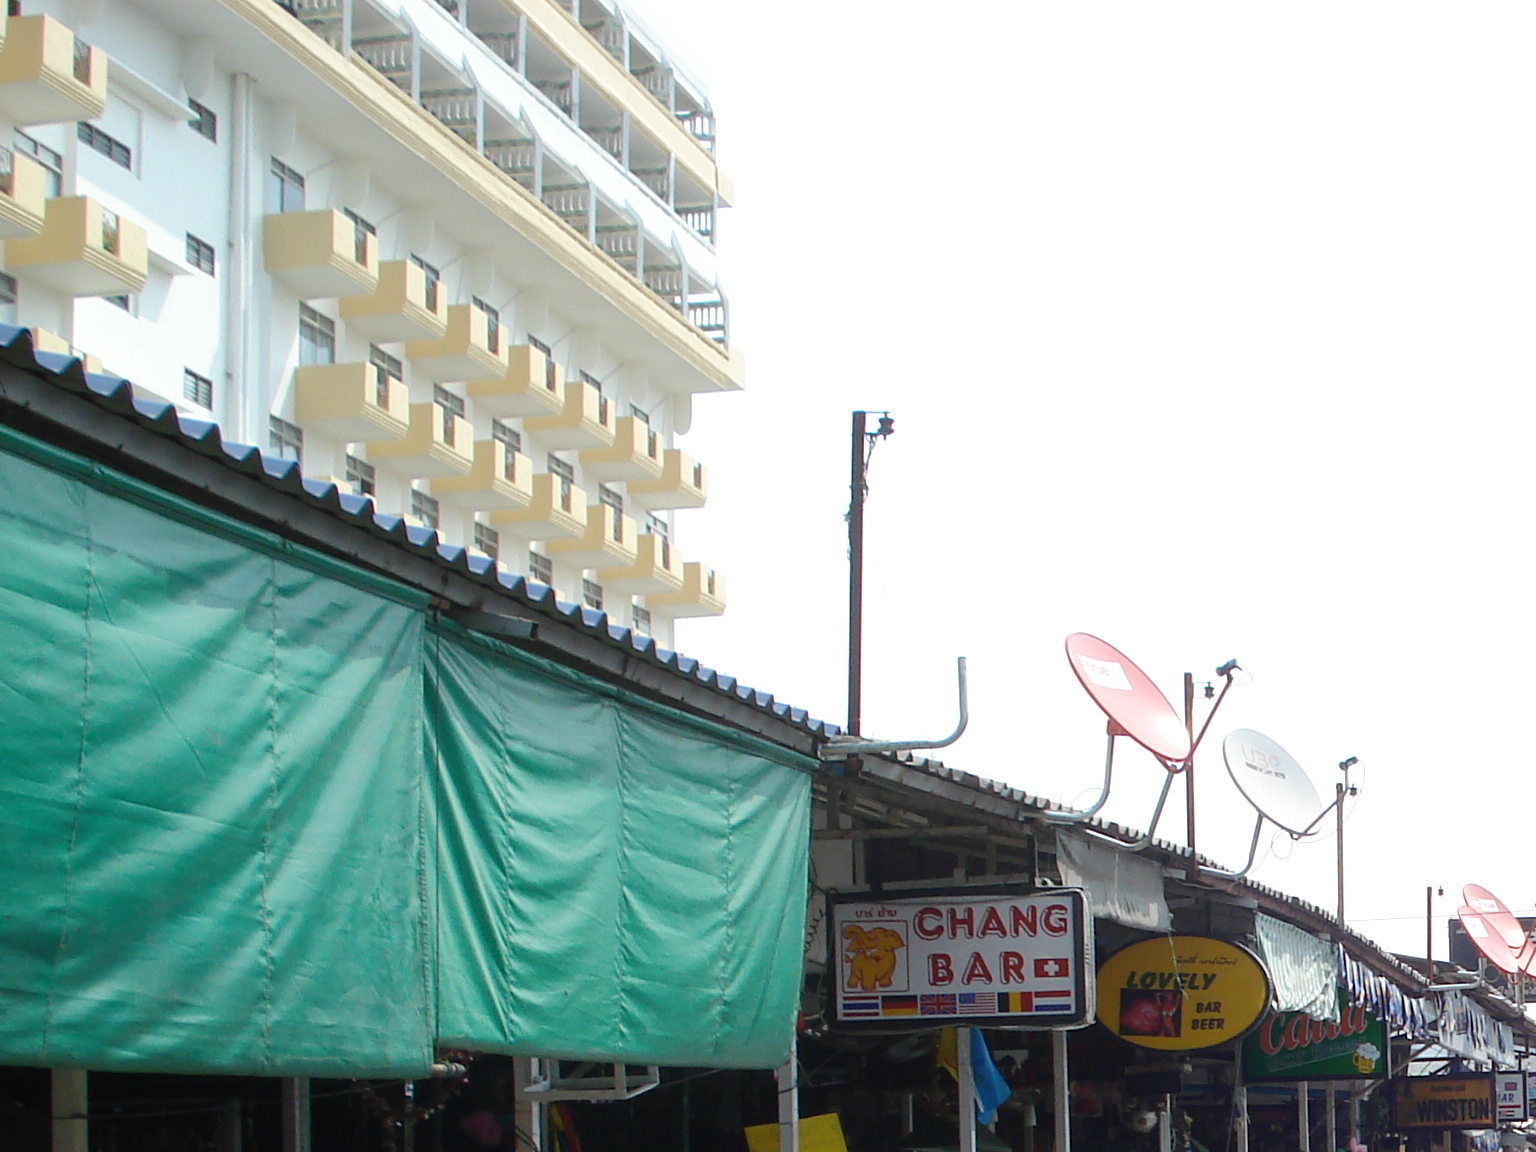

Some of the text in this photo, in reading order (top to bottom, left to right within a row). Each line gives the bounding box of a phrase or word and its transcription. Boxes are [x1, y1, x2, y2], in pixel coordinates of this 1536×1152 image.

[913, 905, 1068, 940] CHANG
[928, 951, 1025, 986] BAR
[1126, 970, 1217, 991] LOVELY
[1196, 1001, 1222, 1014] BAR
[1191, 1018, 1225, 1031] BEER
[1498, 1093, 1514, 1103] AR
[1416, 1098, 1489, 1122] WINSTON
